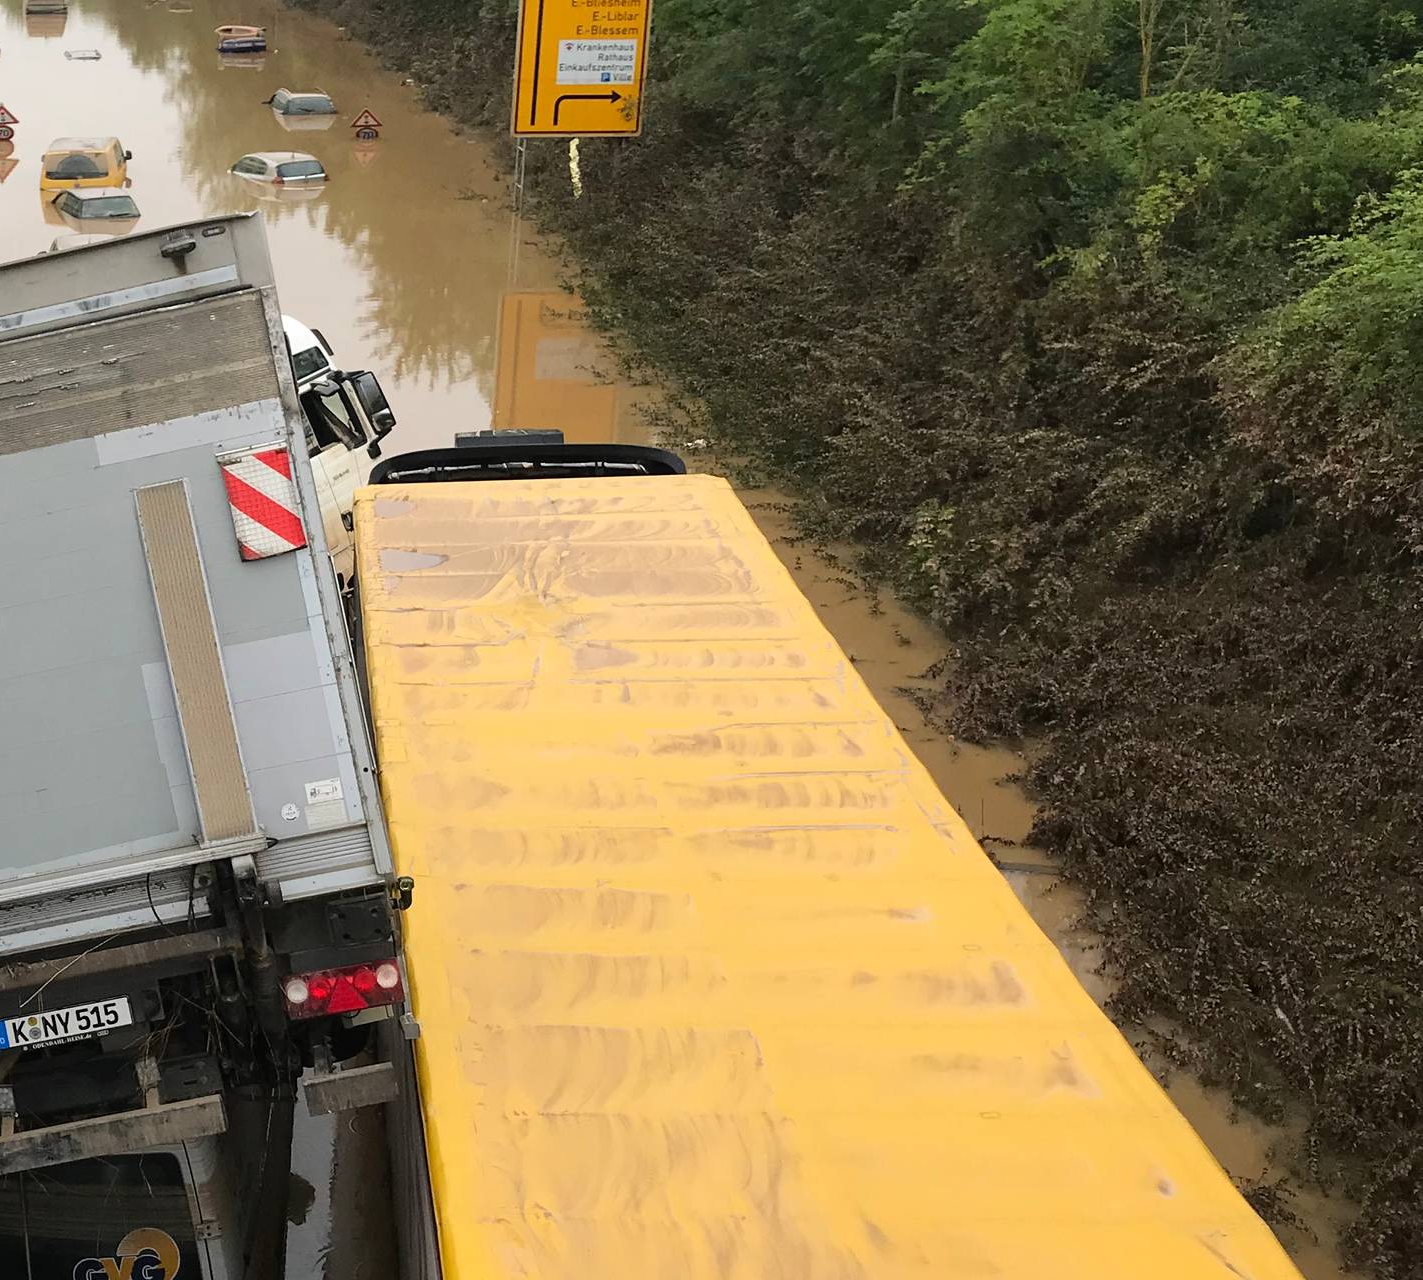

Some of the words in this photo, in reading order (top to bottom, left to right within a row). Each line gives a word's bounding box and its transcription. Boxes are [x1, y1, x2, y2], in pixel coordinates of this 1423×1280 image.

[577, 43, 634, 51] Krankenhaus
[598, 53, 633, 61] Rathaus
[559, 63, 633, 72] Einkaufszentrum
[360, 131, 374, 140] 70
[11, 1020, 29, 1044] K
[41, 1011, 71, 1038] NY
[76, 1002, 120, 1032] 515
[72, 1254, 167, 1280] GVG
